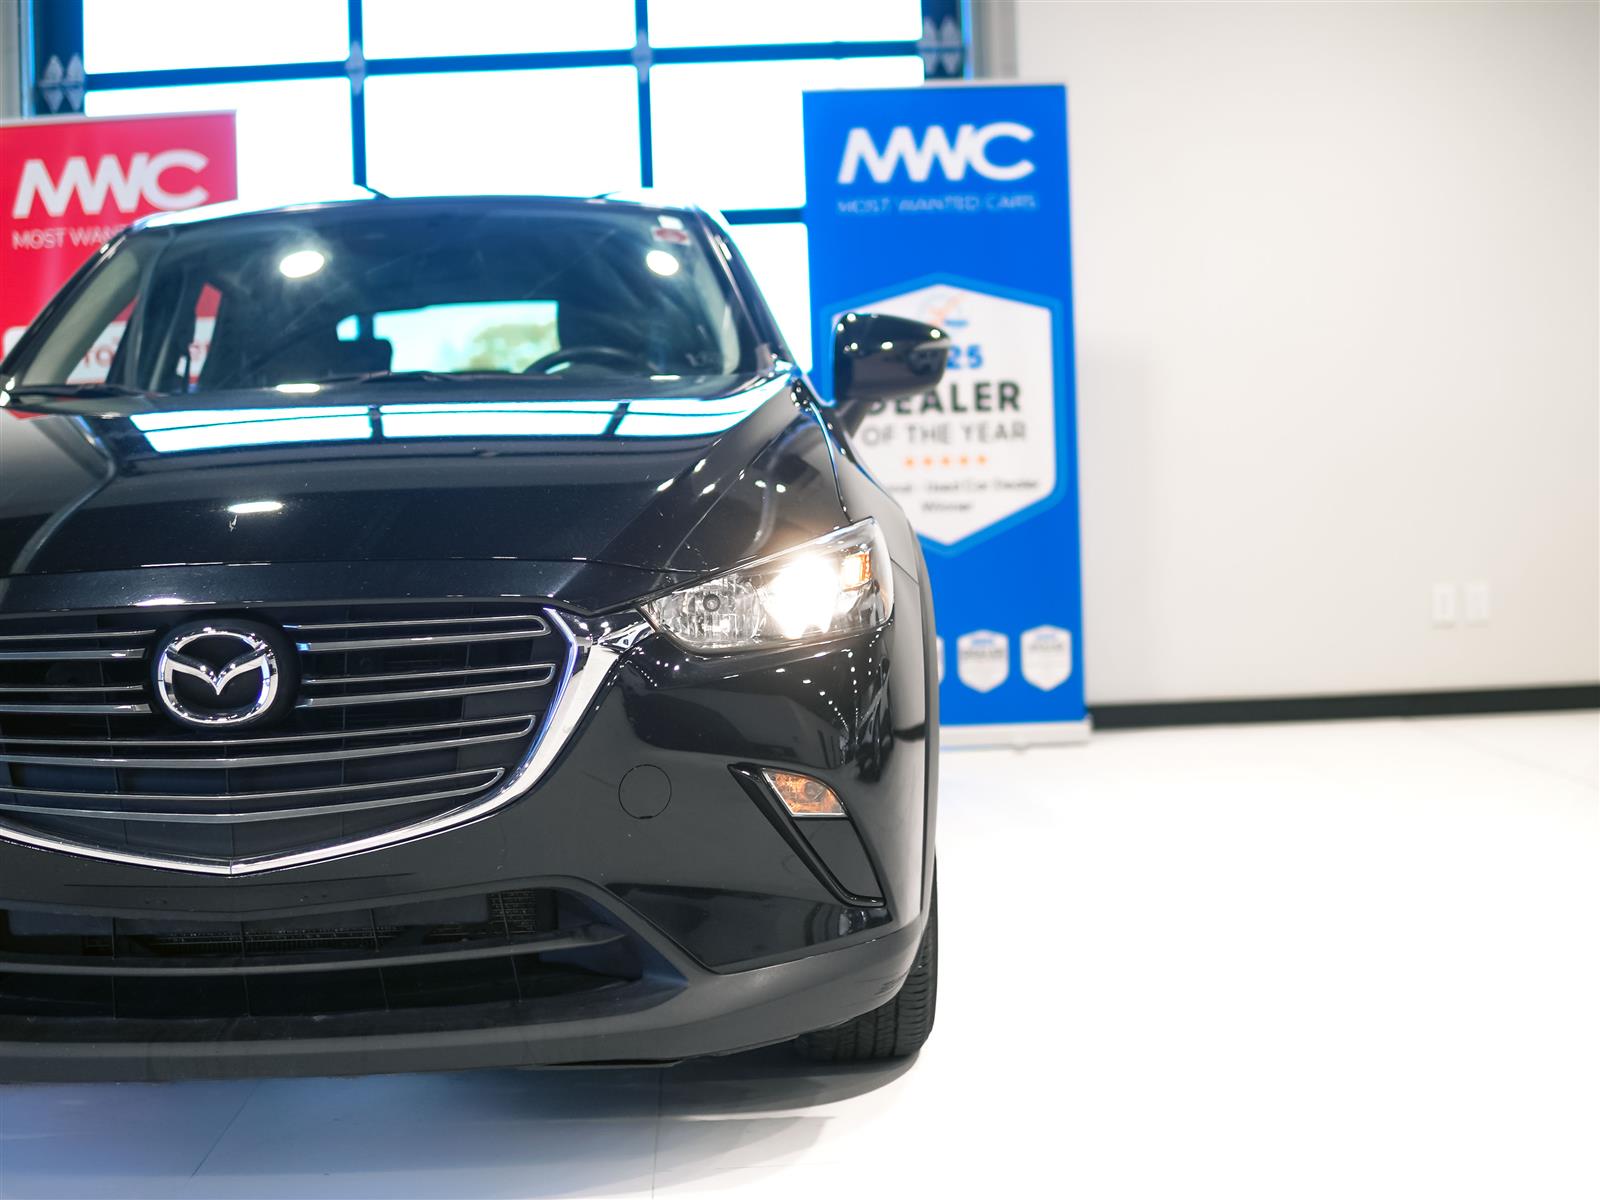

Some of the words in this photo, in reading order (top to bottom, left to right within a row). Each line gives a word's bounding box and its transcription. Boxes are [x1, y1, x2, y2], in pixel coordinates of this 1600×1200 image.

[837, 121, 1036, 185] MWC
[12, 149, 208, 219] MWC
[12, 227, 64, 250] MOST
[69, 223, 127, 248] WAN
[946, 344, 984, 370] 25
[862, 424, 893, 447] OF
[907, 422, 950, 445] THE
[961, 420, 1027, 444] YEAR
